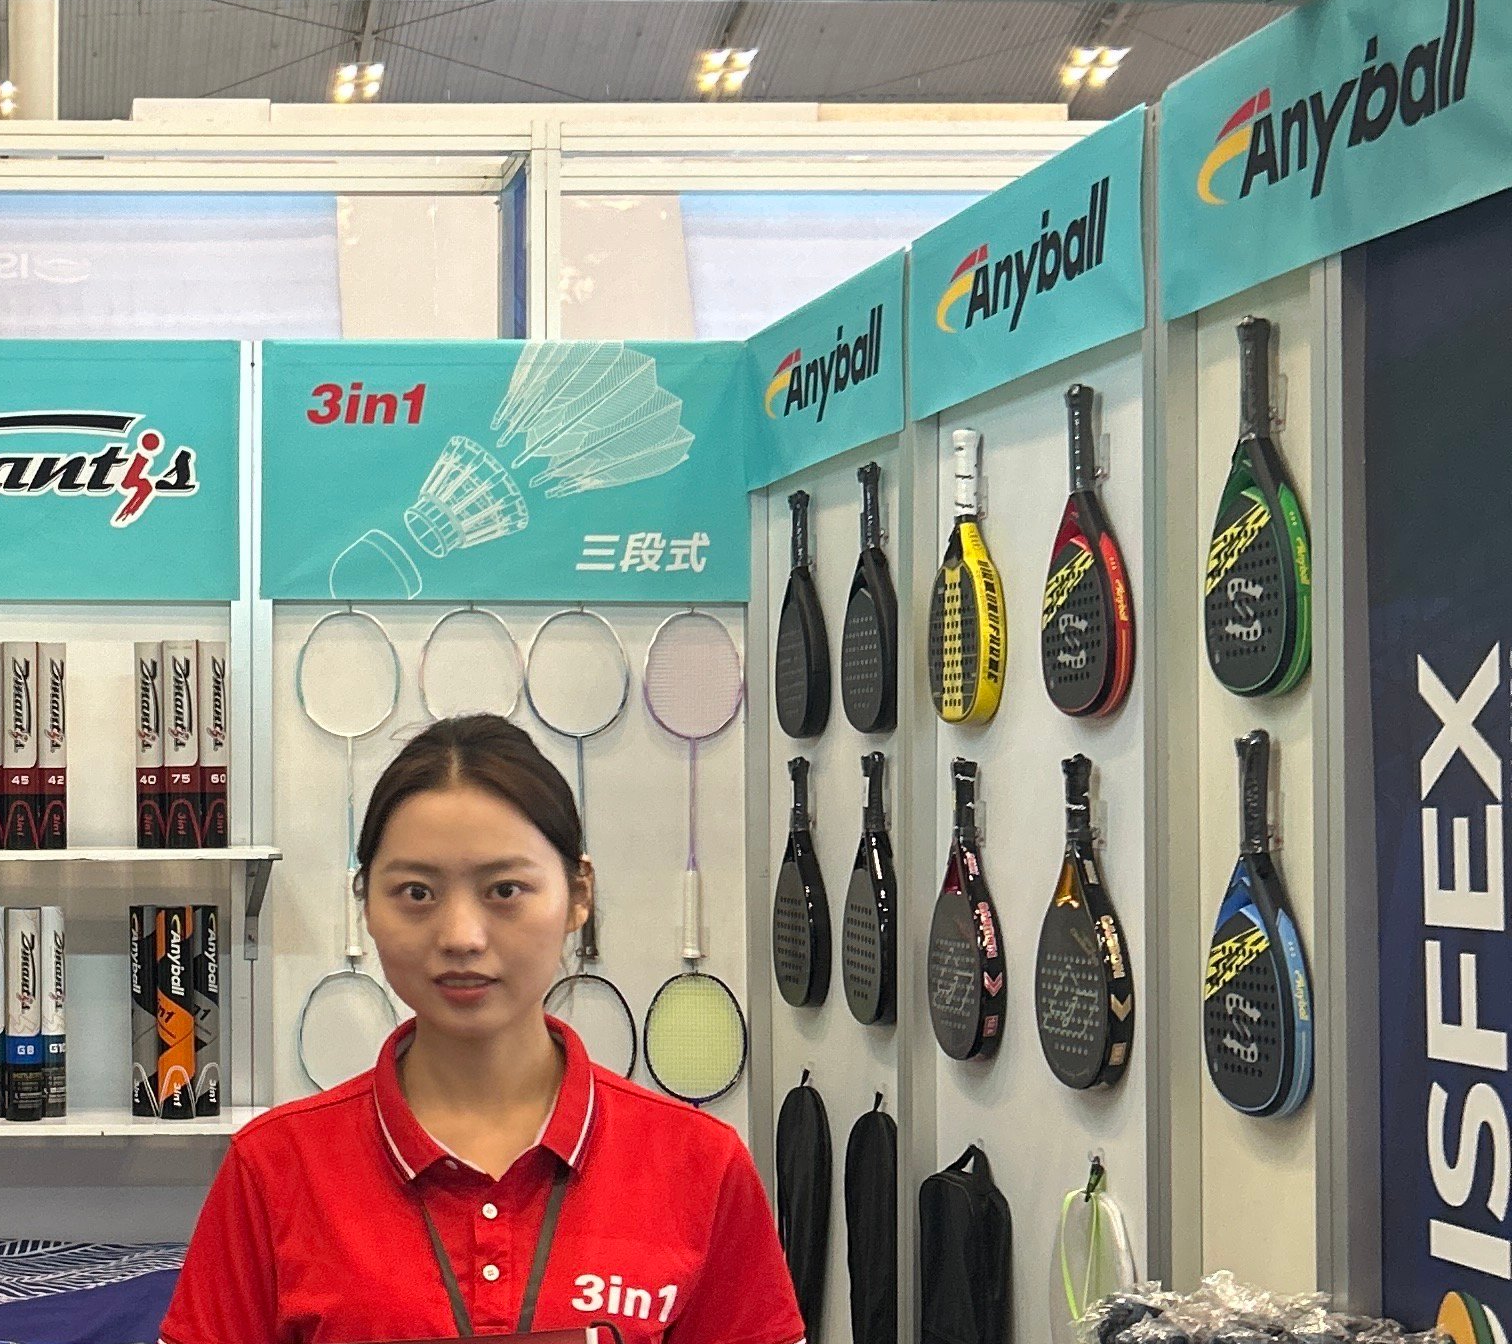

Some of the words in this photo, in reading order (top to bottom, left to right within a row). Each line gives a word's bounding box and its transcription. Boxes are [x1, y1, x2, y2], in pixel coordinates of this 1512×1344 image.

[965, 176, 1109, 333] Anyball
[784, 304, 883, 423] Anyball
[307, 381, 427, 425] 3in1
[576, 532, 710, 574] 三段式
[48, 775, 64, 784] 42
[140, 775, 156, 784] 40
[172, 774, 190, 783] 75
[167, 932, 185, 997] Anyball
[204, 929, 218, 994] Anyball
[1417, 640, 1512, 1280] ISFEX
[571, 1274, 678, 1322] 3in1
